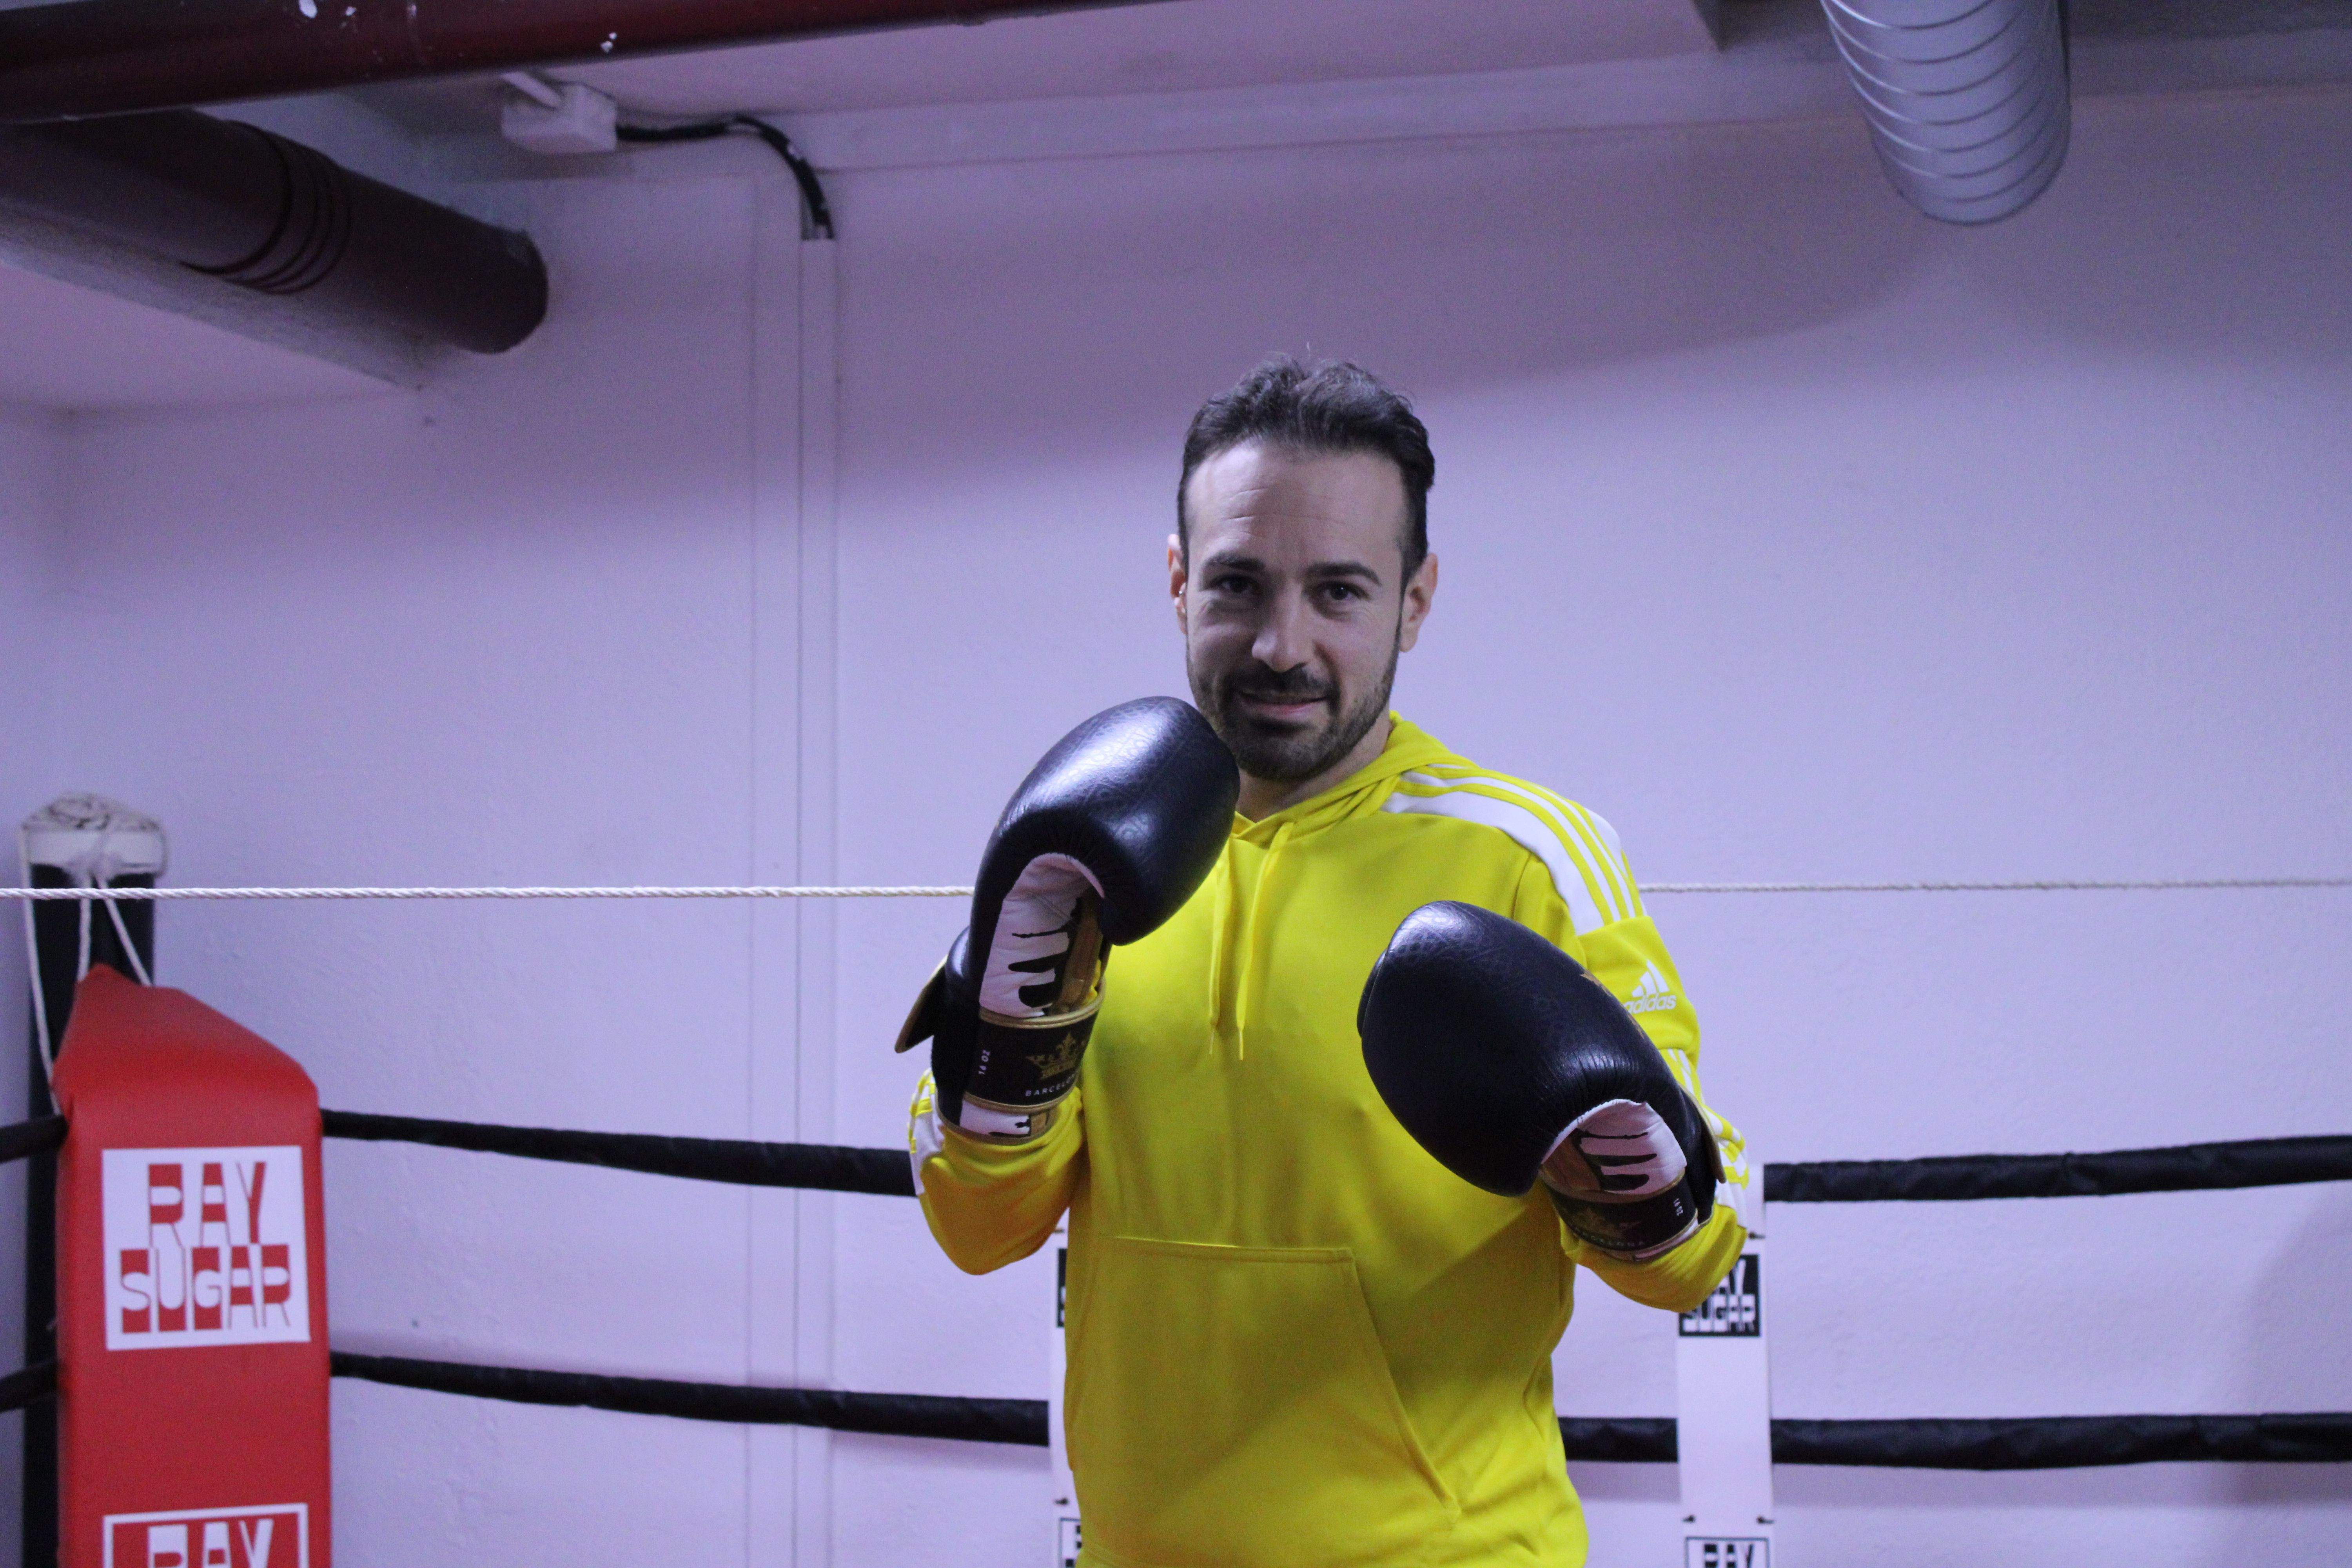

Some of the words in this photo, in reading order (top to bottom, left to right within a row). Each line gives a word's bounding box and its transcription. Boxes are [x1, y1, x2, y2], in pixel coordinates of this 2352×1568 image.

[1623, 994, 1677, 1014] adidas
[147, 1162, 267, 1248] RAY
[120, 1244, 291, 1333] SUGAR
